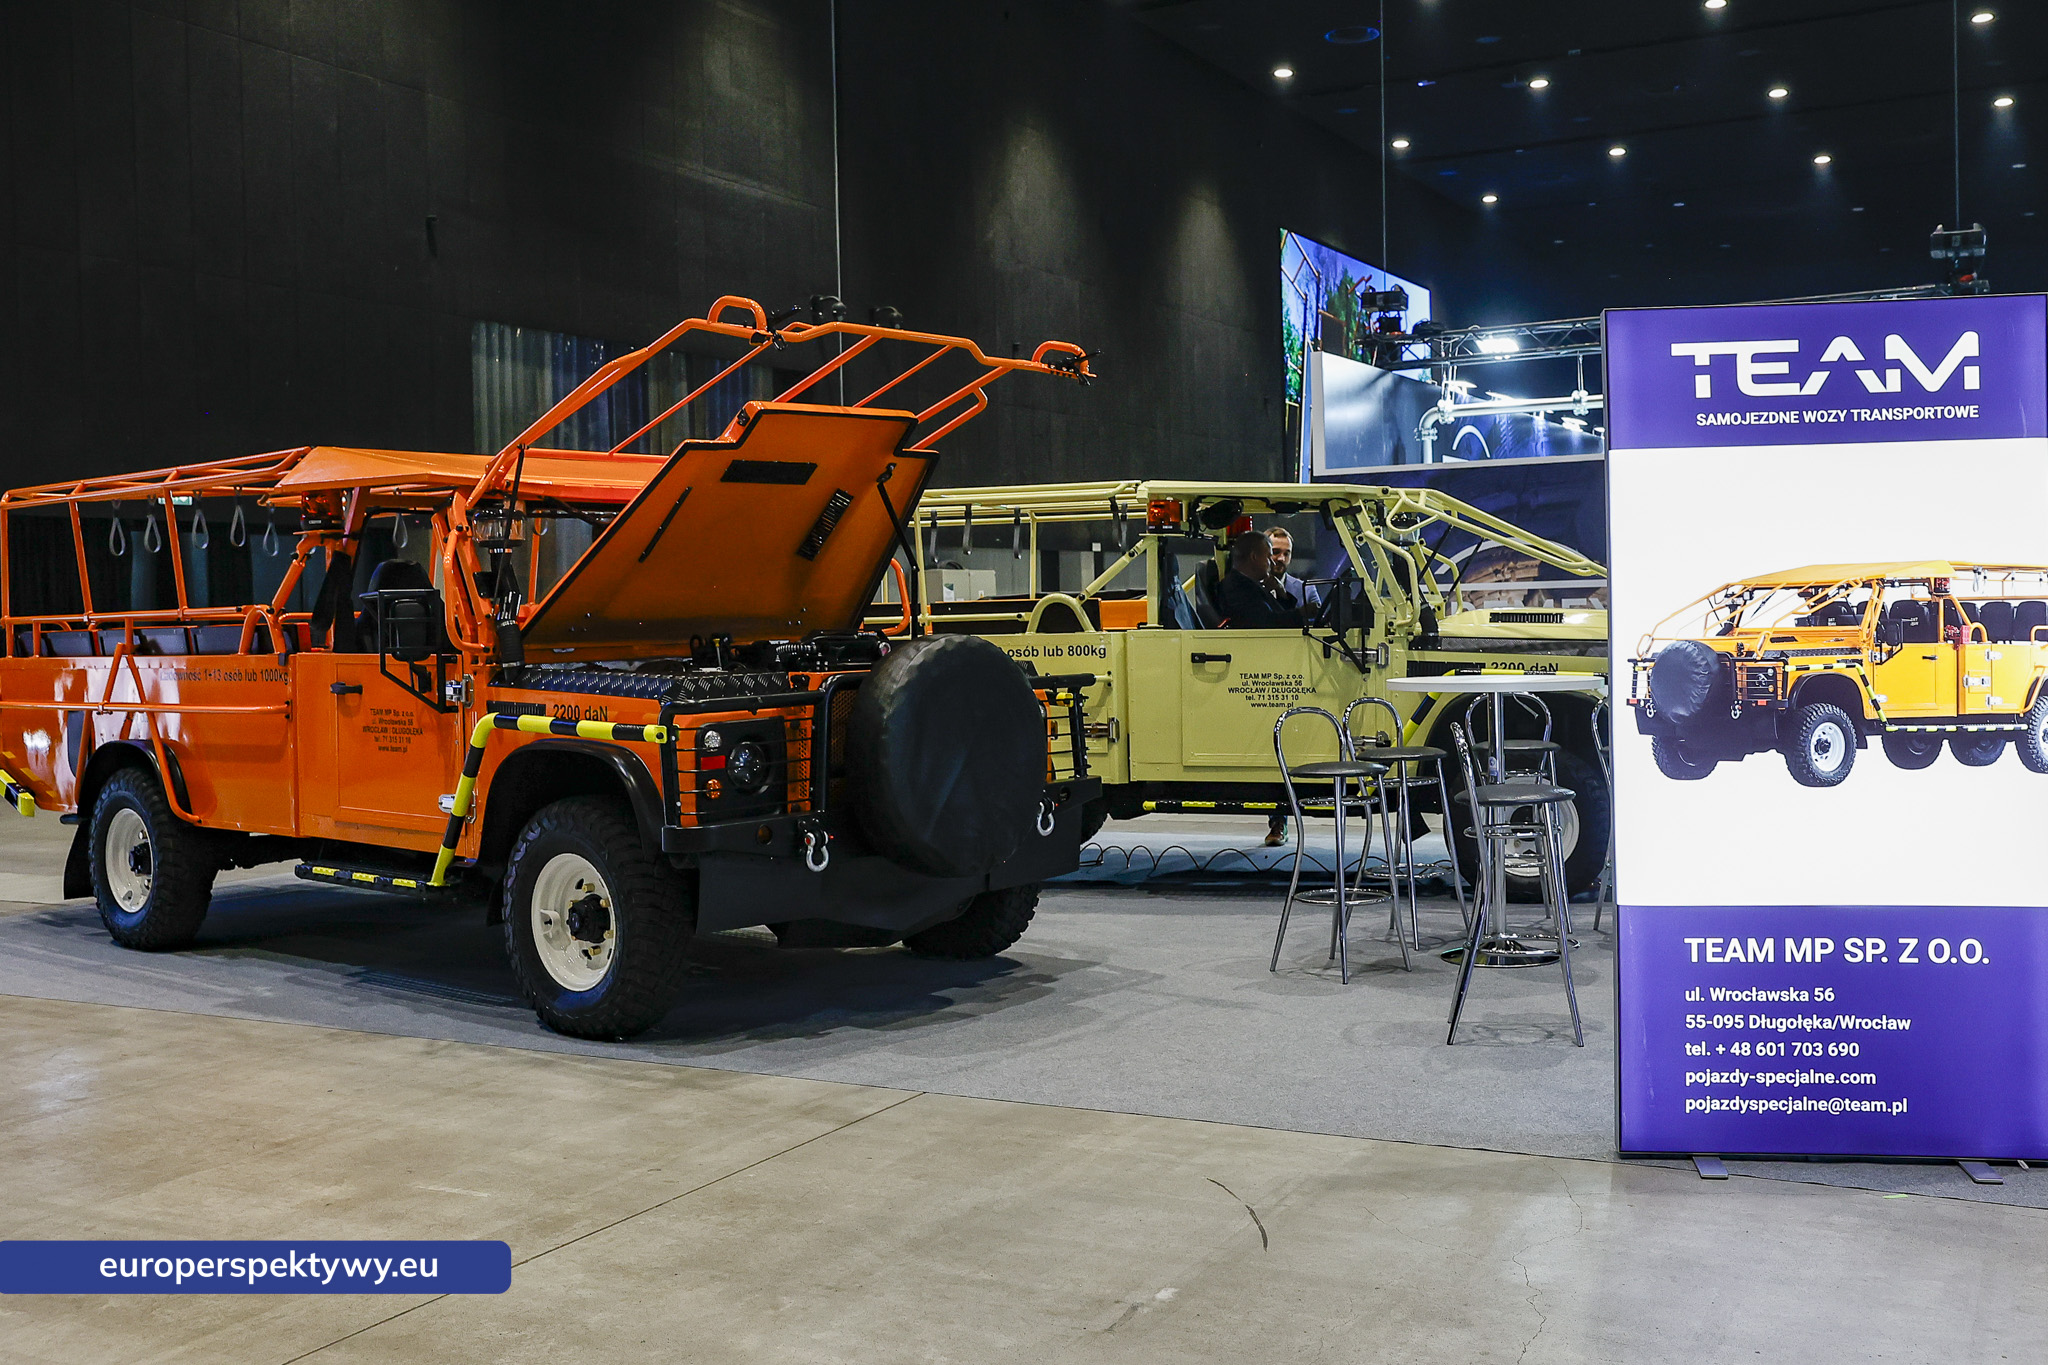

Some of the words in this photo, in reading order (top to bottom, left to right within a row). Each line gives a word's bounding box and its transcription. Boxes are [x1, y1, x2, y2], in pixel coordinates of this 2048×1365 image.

[1670, 331, 1980, 398] TEAM
[1696, 410, 1799, 426] SAMOJEZDNE
[1803, 408, 1848, 423] WOZY
[1850, 405, 1980, 422] TRANSPORTOWE
[1008, 646, 1039, 657] osób
[1044, 646, 1063, 656] lub
[1068, 645, 1106, 658] 800kg
[224, 668, 242, 682] osób
[245, 669, 257, 682] lub
[260, 668, 288, 685] 1000kg
[553, 704, 580, 720] 2200
[584, 706, 608, 721] daN
[1684, 938, 1775, 964] TEAM
[1784, 938, 1834, 964] MP
[1844, 938, 1888, 964] SP.
[1898, 938, 1919, 964] Z
[1928, 938, 1990, 964] O.O.
[1685, 988, 1705, 1002] ul.
[1710, 988, 1809, 1002] Wrocławska
[1814, 988, 1834, 1002] 56
[1685, 1015, 1744, 1030] 55-095
[1749, 1014, 1911, 1033] Długołęka/Wrocław
[1685, 1042, 1711, 1056] tel.
[1716, 1044, 1726, 1054] +
[1730, 1042, 1751, 1056] 48
[1756, 1042, 1785, 1056] 601
[1792, 1042, 1823, 1056] 703
[1828, 1042, 1860, 1057] 690
[1686, 1069, 1876, 1088] pojazdy-specjalne.com
[1686, 1096, 1908, 1115] pojazdyspecjalne@team.pl
